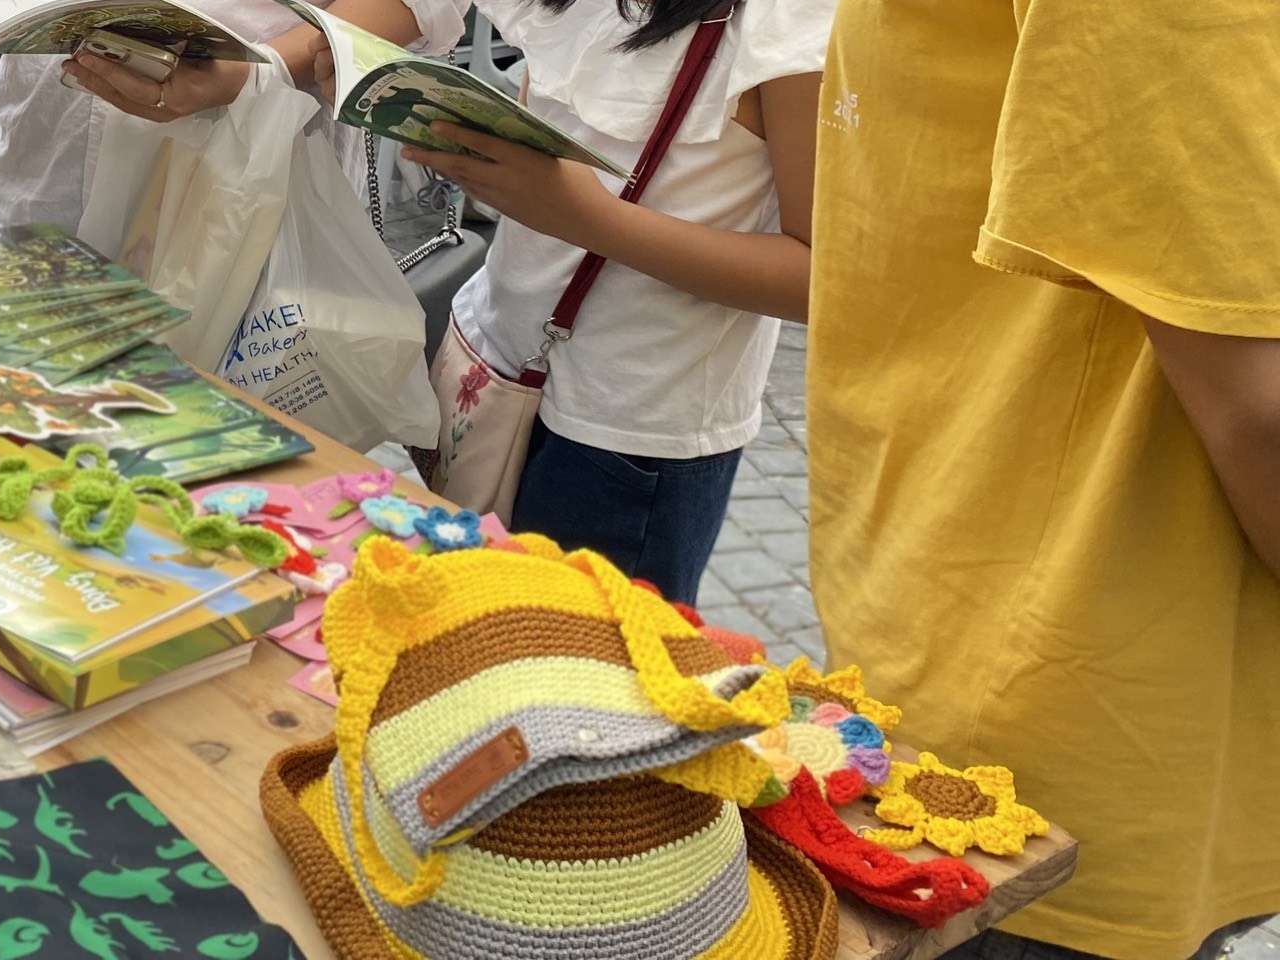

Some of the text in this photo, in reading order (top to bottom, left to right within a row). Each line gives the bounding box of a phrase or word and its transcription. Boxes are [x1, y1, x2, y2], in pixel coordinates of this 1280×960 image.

[248, 329, 307, 357] Bakery
[11, 551, 61, 578] Vật
[65, 571, 120, 613] Động
